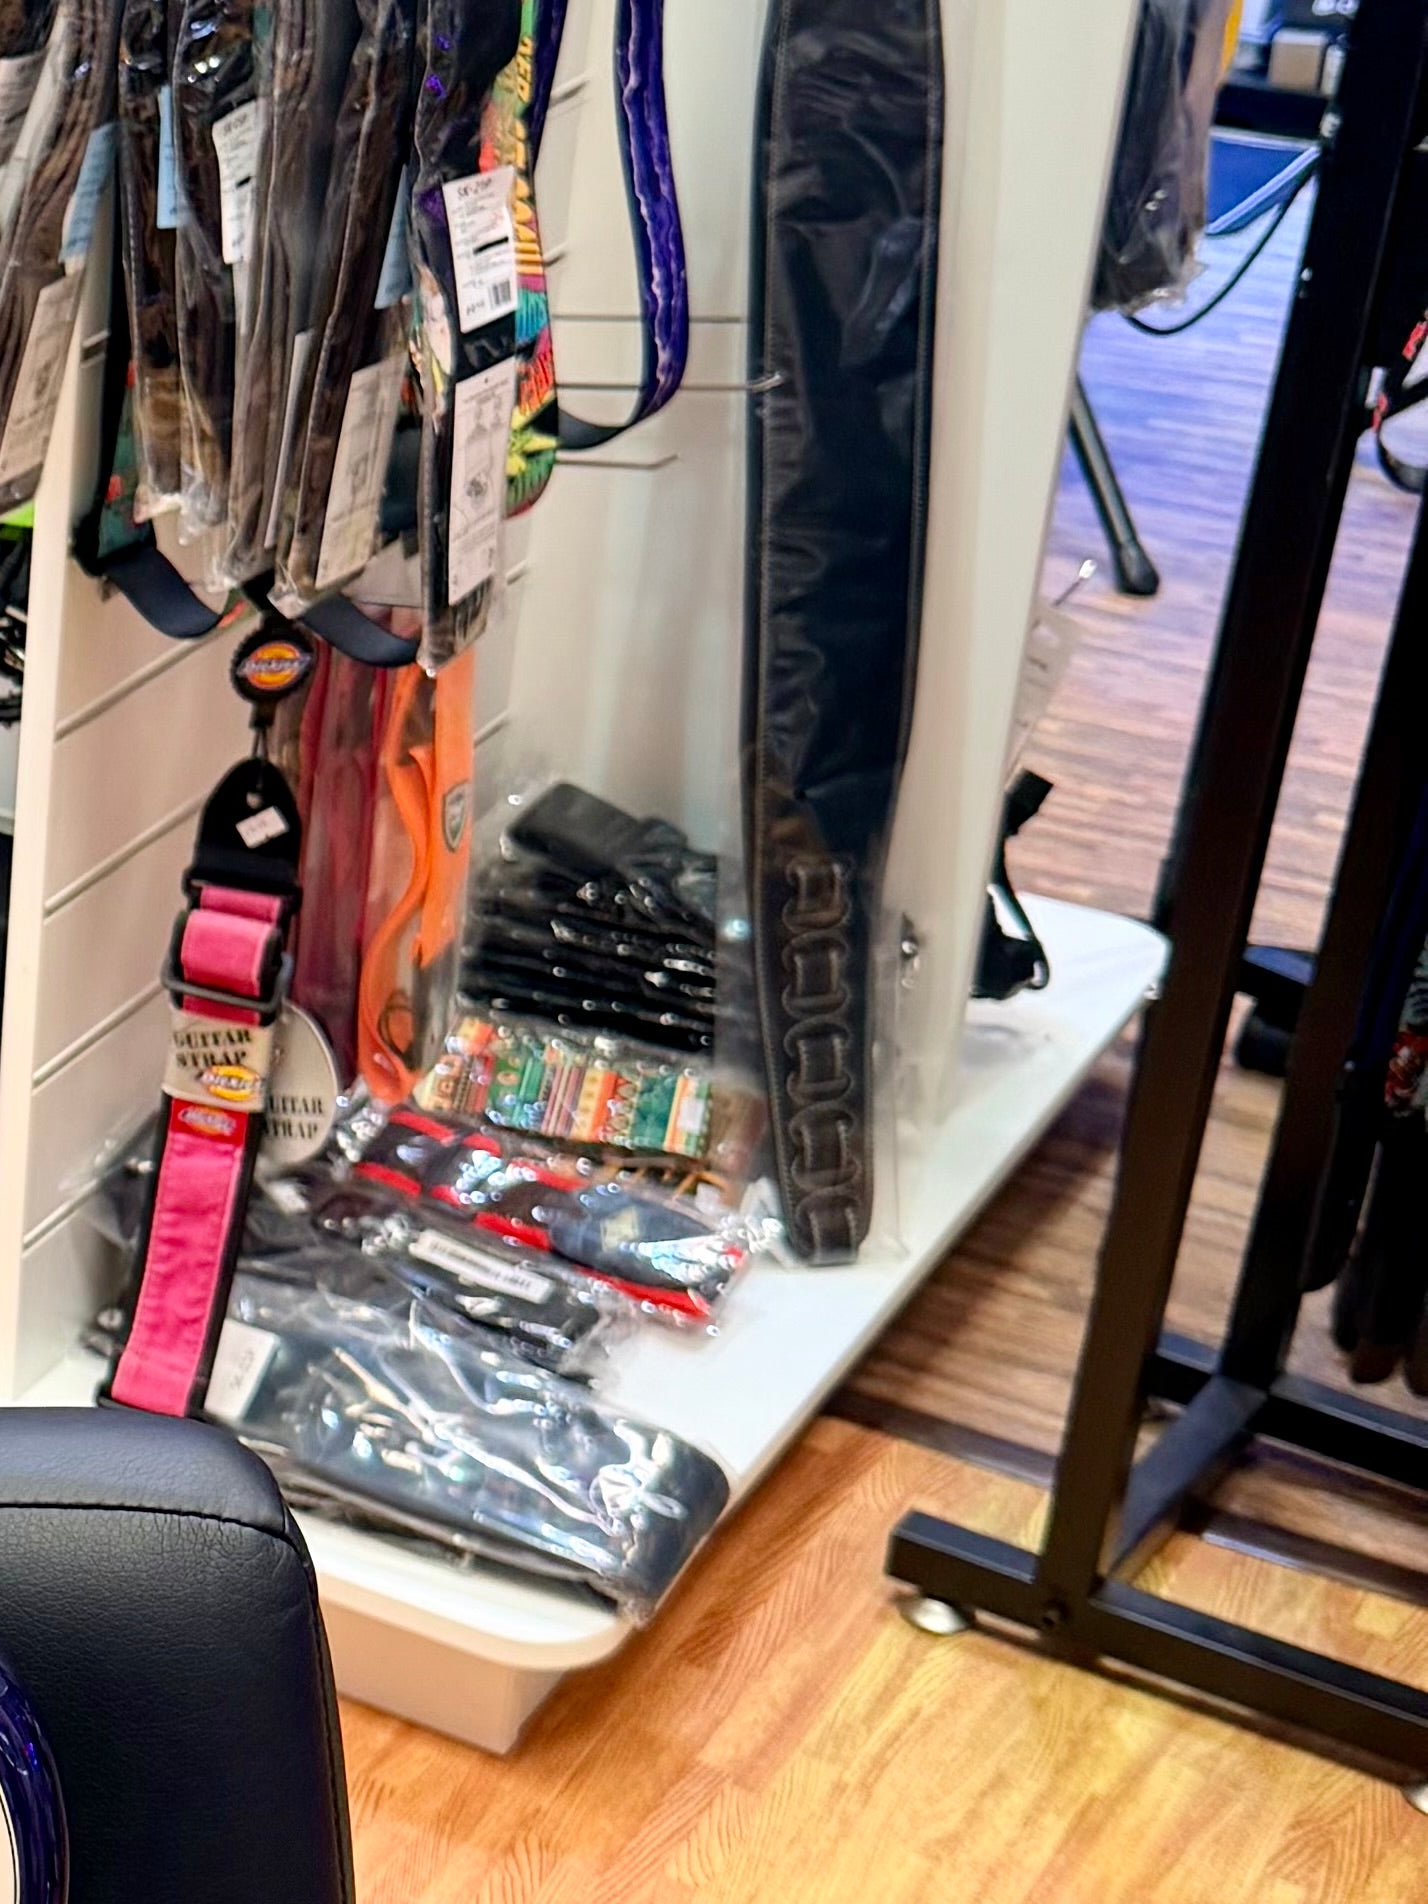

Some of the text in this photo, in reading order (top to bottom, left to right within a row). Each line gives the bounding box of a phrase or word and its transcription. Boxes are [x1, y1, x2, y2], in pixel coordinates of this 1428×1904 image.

[174, 1028, 253, 1049] GUITAR
[176, 1050, 247, 1068] STRAP
[269, 1095, 325, 1115] UITAR
